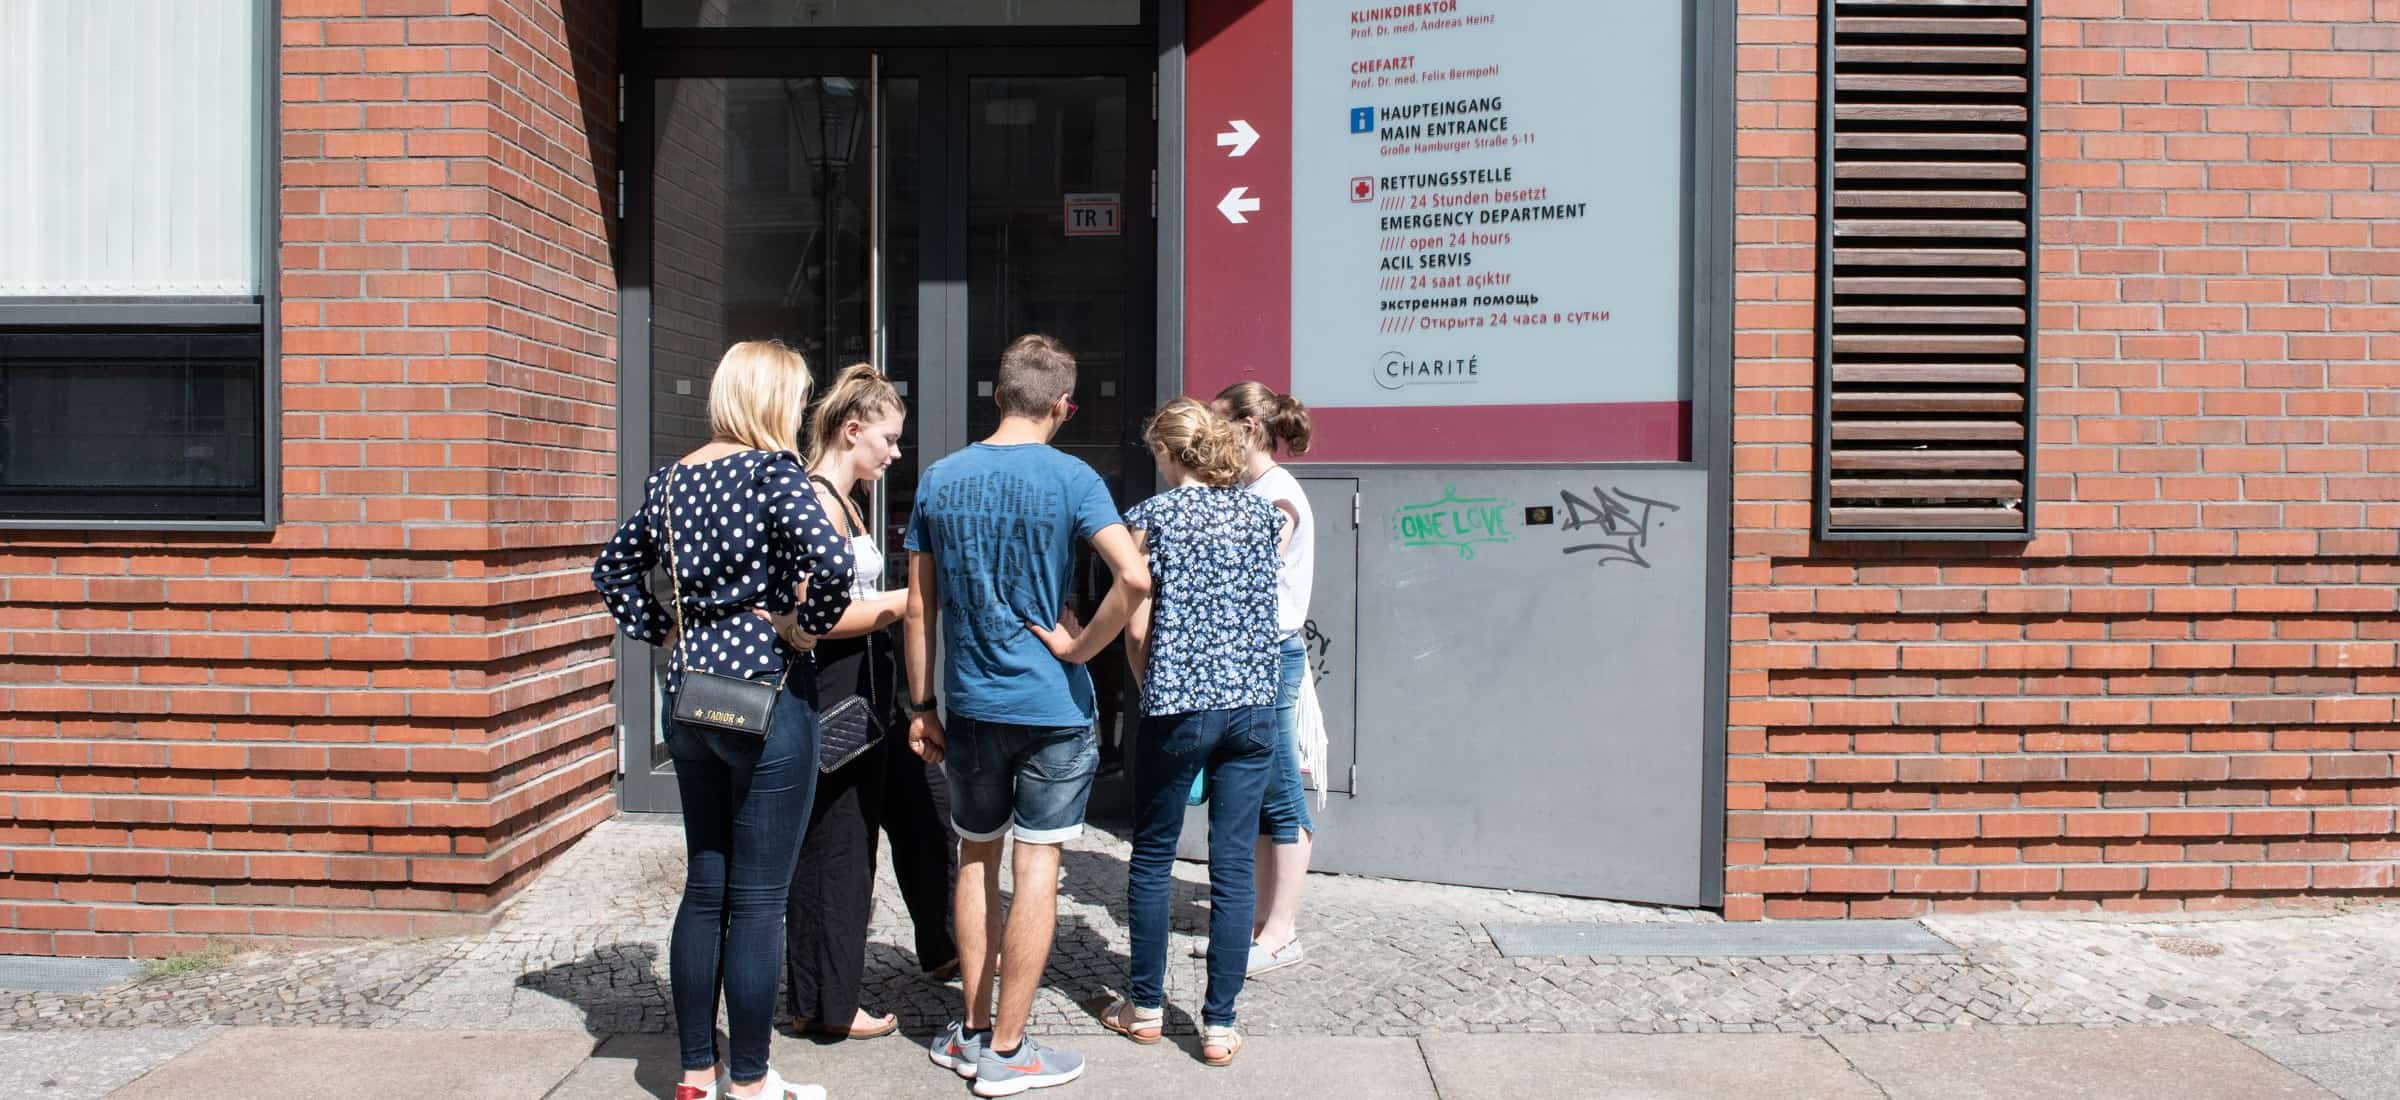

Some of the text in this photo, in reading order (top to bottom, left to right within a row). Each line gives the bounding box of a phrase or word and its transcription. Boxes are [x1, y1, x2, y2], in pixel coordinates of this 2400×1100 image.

[1351, 0, 1457, 24] KLINIKDIREKTOR
[1351, 14, 1495, 40] Prof. Dr. med. Andreas Heinz
[1351, 56, 1415, 74] CHEFARZT
[1351, 64, 1499, 89] Prof. Dr. med. Felix Bermpohl
[1381, 96, 1502, 121] HAUPTEINGANG
[1381, 116, 1508, 141] MAIN ENTRANCE
[1380, 133, 1535, 157] Große Hamburger Straße 5-11
[1381, 167, 1512, 191] RETTUNGSSTELLE
[1410, 194, 1427, 209] 24
[1432, 190, 1489, 207] Stunden
[1495, 187, 1547, 203] besetzt
[1073, 209, 1113, 227] TR 1
[1381, 203, 1586, 231] EMERGENCY DEPARTMENT
[1409, 237, 1443, 251] open
[1449, 233, 1466, 247] 24
[1471, 231, 1511, 246] hours
[1381, 252, 1472, 270] ACIL SERVIS
[1410, 276, 1426, 290] 24
[1431, 274, 1461, 288] saat
[1380, 293, 1539, 312] экстренная помощь
[1420, 316, 1484, 332] Открыта
[1490, 313, 1508, 326] 24
[1513, 313, 1547, 325] часа
[1553, 313, 1561, 323] в
[1567, 310, 1610, 326] сутки
[1386, 354, 1478, 377] CHARITÉ
[936, 471, 1056, 519] SUNSHINE
[936, 511, 1055, 551] NOMAD
[1401, 505, 1511, 538] ONE LOVE
